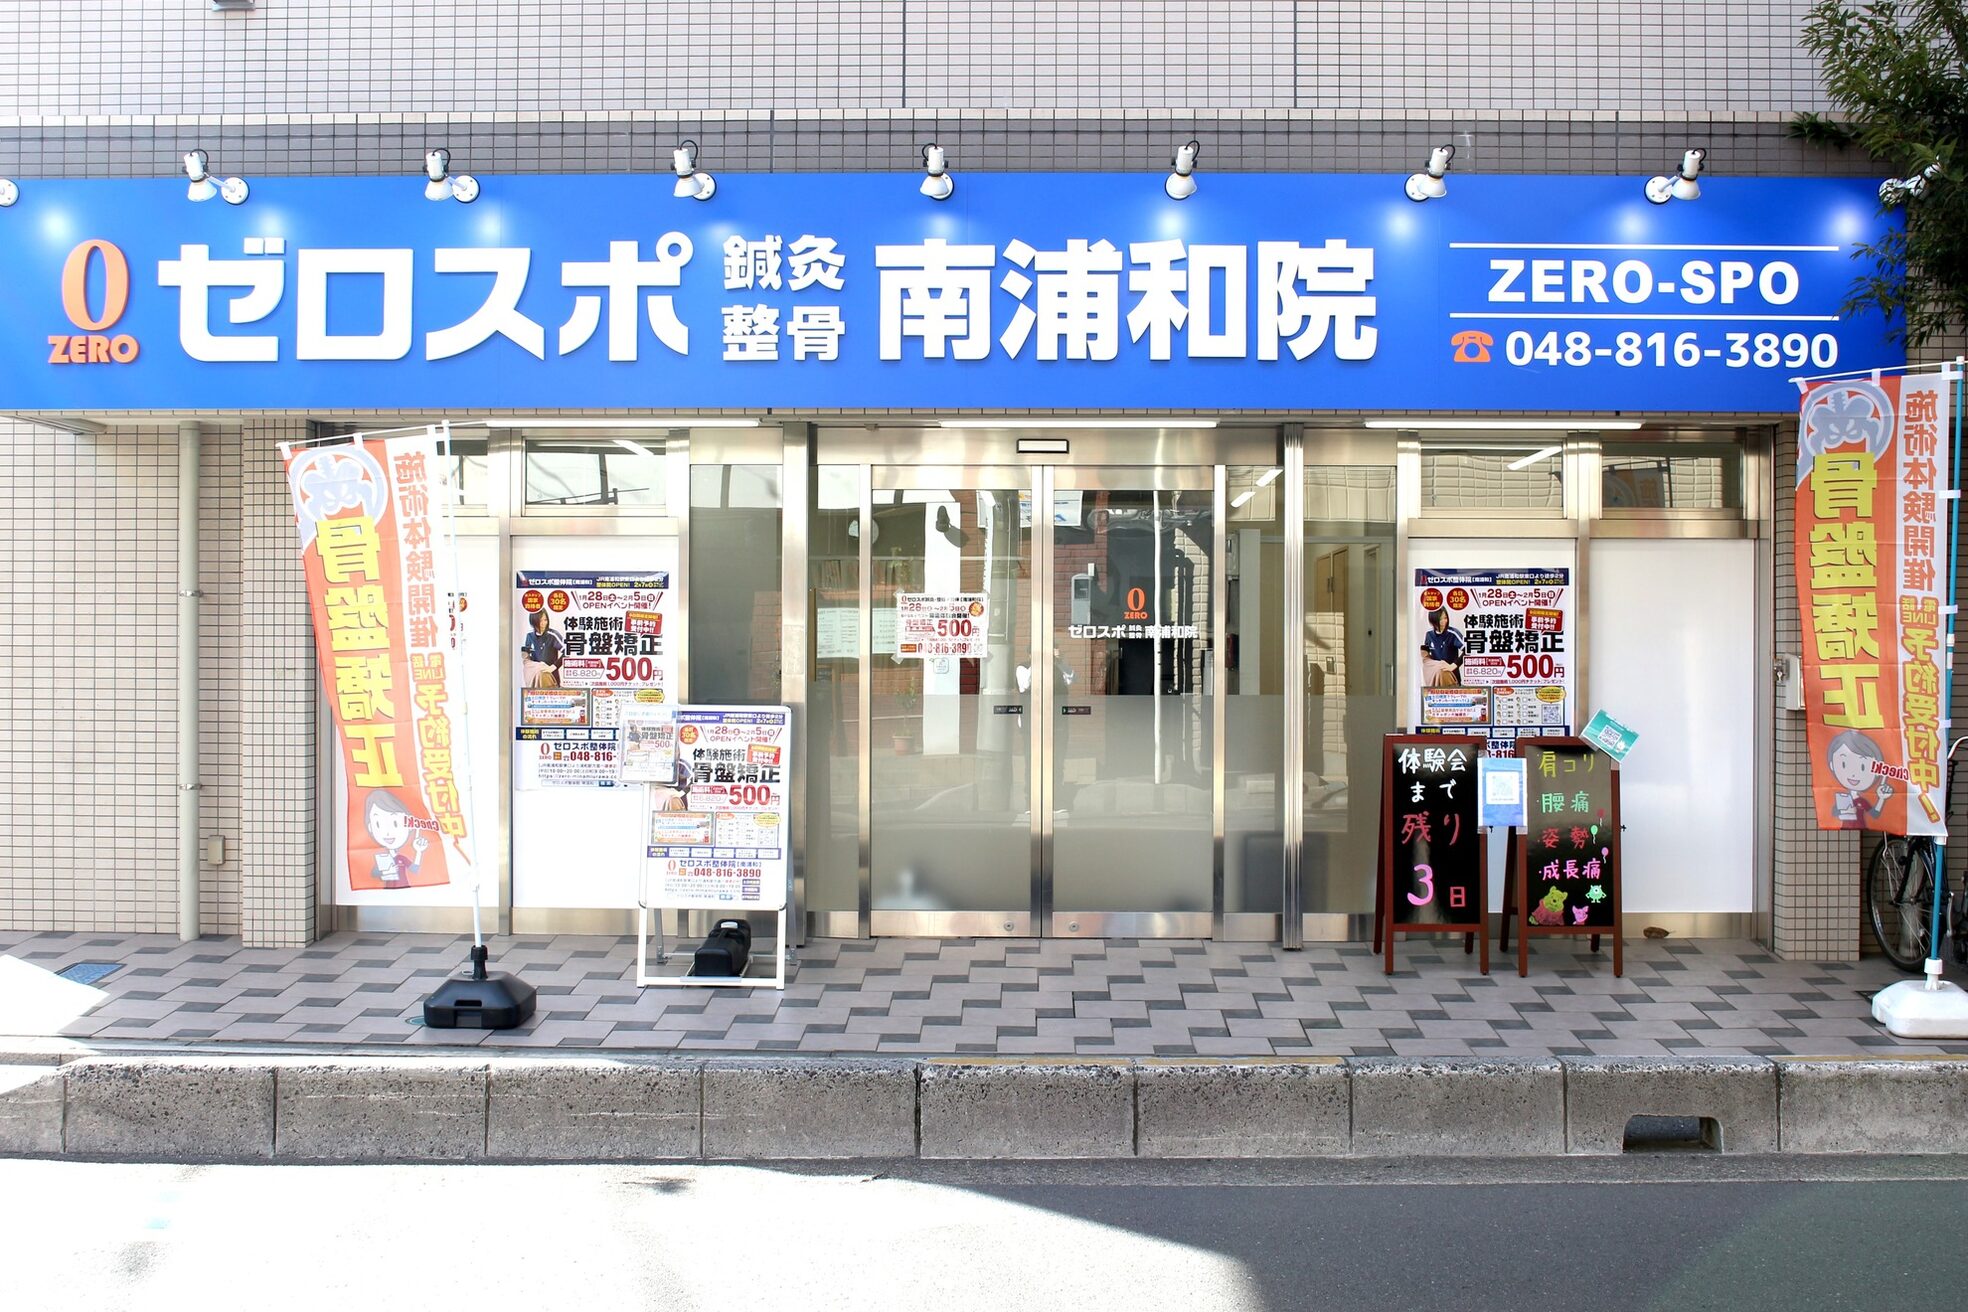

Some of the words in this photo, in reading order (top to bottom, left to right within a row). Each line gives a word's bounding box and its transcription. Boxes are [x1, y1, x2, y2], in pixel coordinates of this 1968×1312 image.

[722, 234, 846, 291] 鍼灸
[61, 238, 130, 331] 0
[1488, 259, 1800, 305] ZERO-SPO
[158, 231, 694, 361] ゼロスポ
[875, 239, 1378, 361] 南浦和院
[721, 304, 846, 361] 整骨
[47, 335, 140, 365] ZERO
[1505, 331, 1839, 367] 048-816-3890
[1482, 599, 1552, 607] OPENイベント開催!
[564, 616, 623, 631] 体験施術
[1124, 612, 1149, 620] ZERO
[1464, 614, 1524, 629] 体験施術
[1068, 624, 1127, 639] ゼロスポ
[1144, 625, 1198, 639] 南浦和院
[1464, 630, 1564, 653] 骨盤矯正
[564, 632, 663, 656] 骨盤矯正
[1507, 654, 1564, 678] 500円
[693, 748, 746, 761] 体験施術
[1398, 747, 1467, 775] 体験会
[1539, 751, 1596, 778] 肩コリ
[692, 763, 781, 784] 骨盤矯正
[1411, 780, 1458, 803] まで
[1541, 791, 1590, 814] 腰痛
[1401, 810, 1462, 846] 残り
[1543, 826, 1590, 849] 姿勢
[1542, 857, 1601, 881] 成長痛
[1406, 864, 1467, 908] 3日
